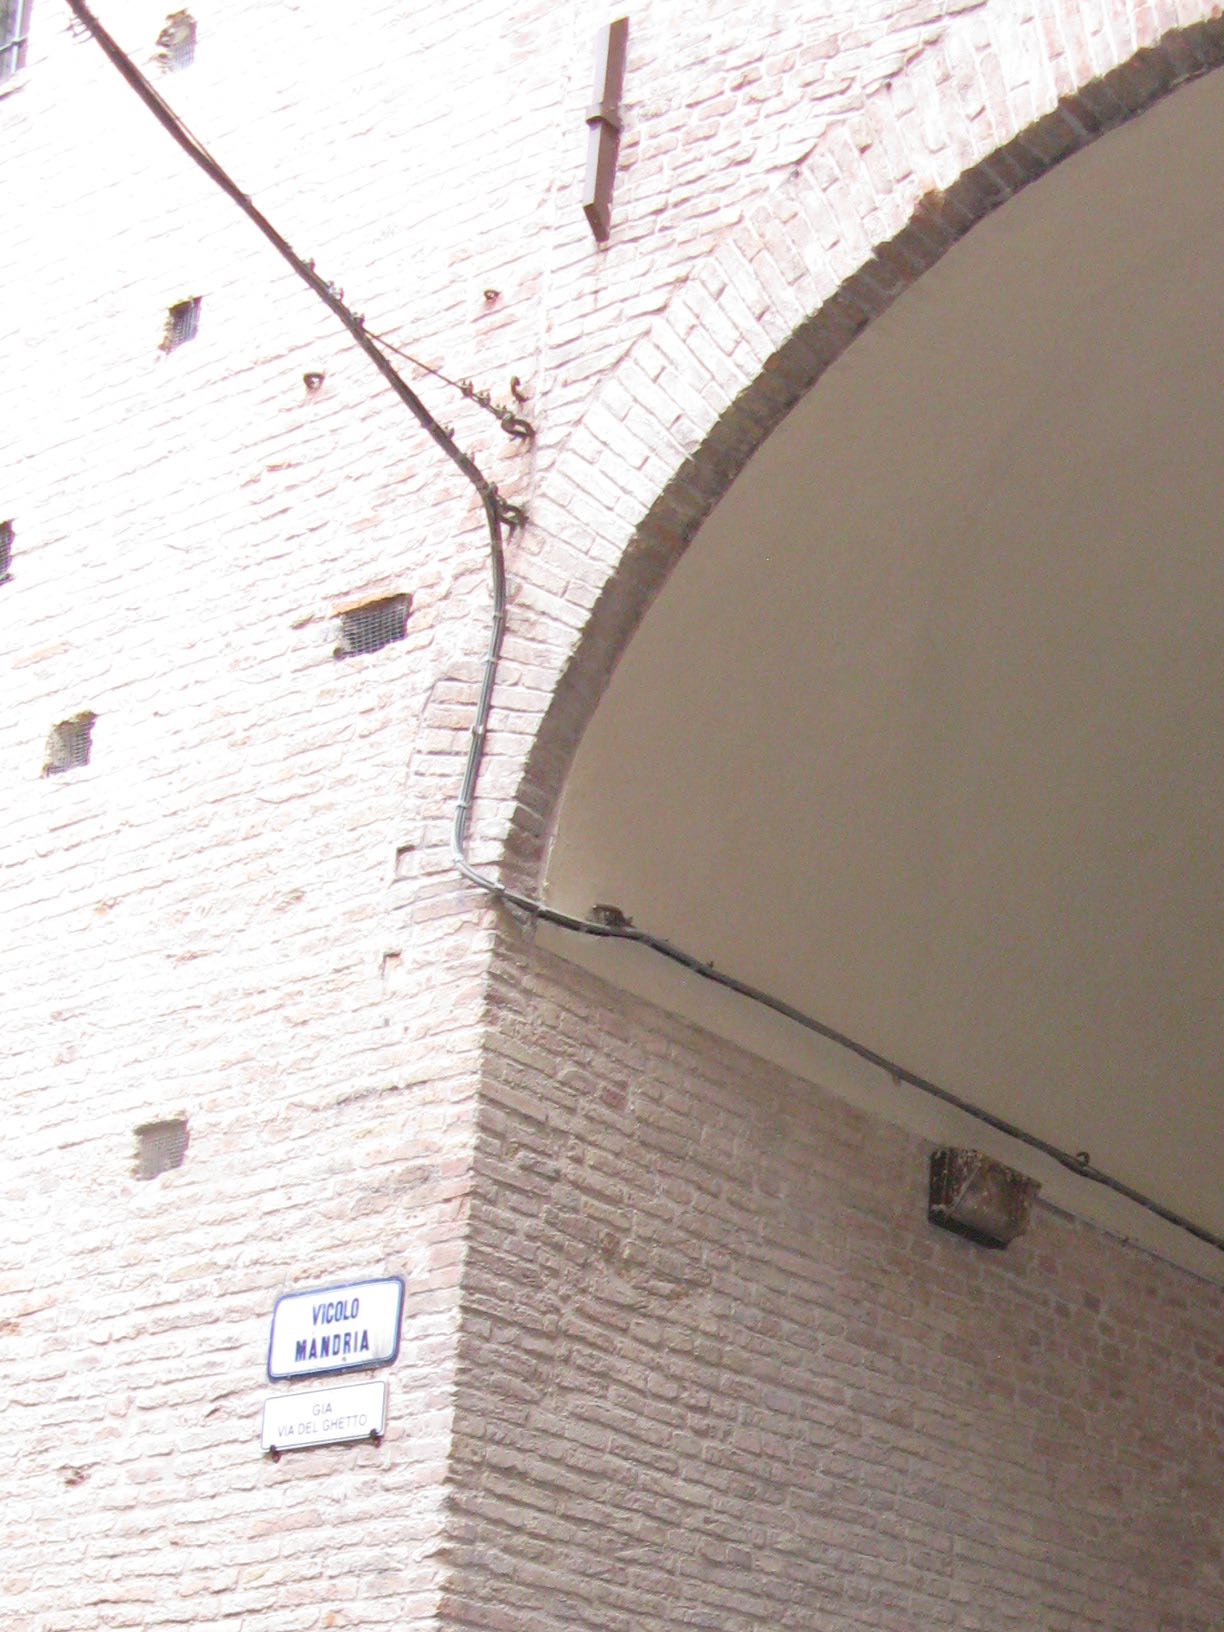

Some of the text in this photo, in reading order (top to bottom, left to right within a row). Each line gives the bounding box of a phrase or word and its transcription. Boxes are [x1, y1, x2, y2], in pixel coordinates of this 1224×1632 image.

[312, 1298, 359, 1326] VICOLO
[295, 1330, 369, 1362] MANDRIA
[278, 1414, 367, 1437] VIA DEL GHETTO
